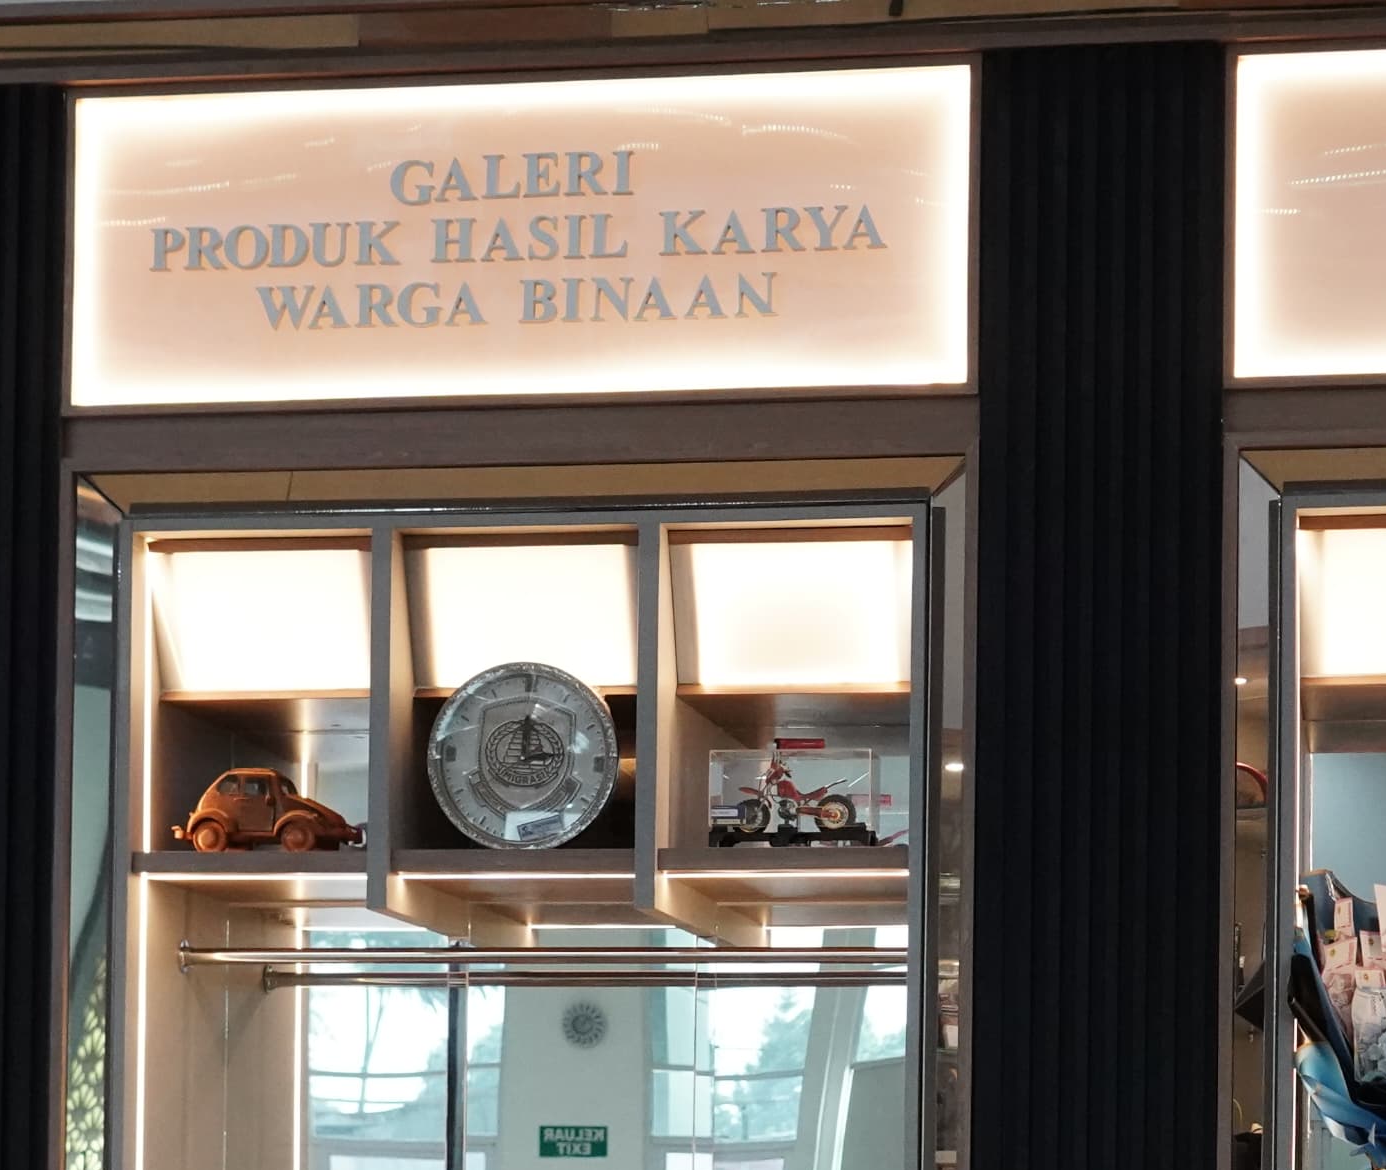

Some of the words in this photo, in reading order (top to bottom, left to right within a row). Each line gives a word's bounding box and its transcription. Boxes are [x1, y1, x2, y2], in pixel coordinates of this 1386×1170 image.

[389, 150, 635, 205] GALERI
[149, 221, 401, 272] PRODUK
[430, 213, 629, 265] HASIL
[659, 204, 888, 257] KARYA
[256, 281, 487, 331] WARGA
[519, 271, 779, 324] BINAAN
[499, 767, 550, 785] IMIGRASI
